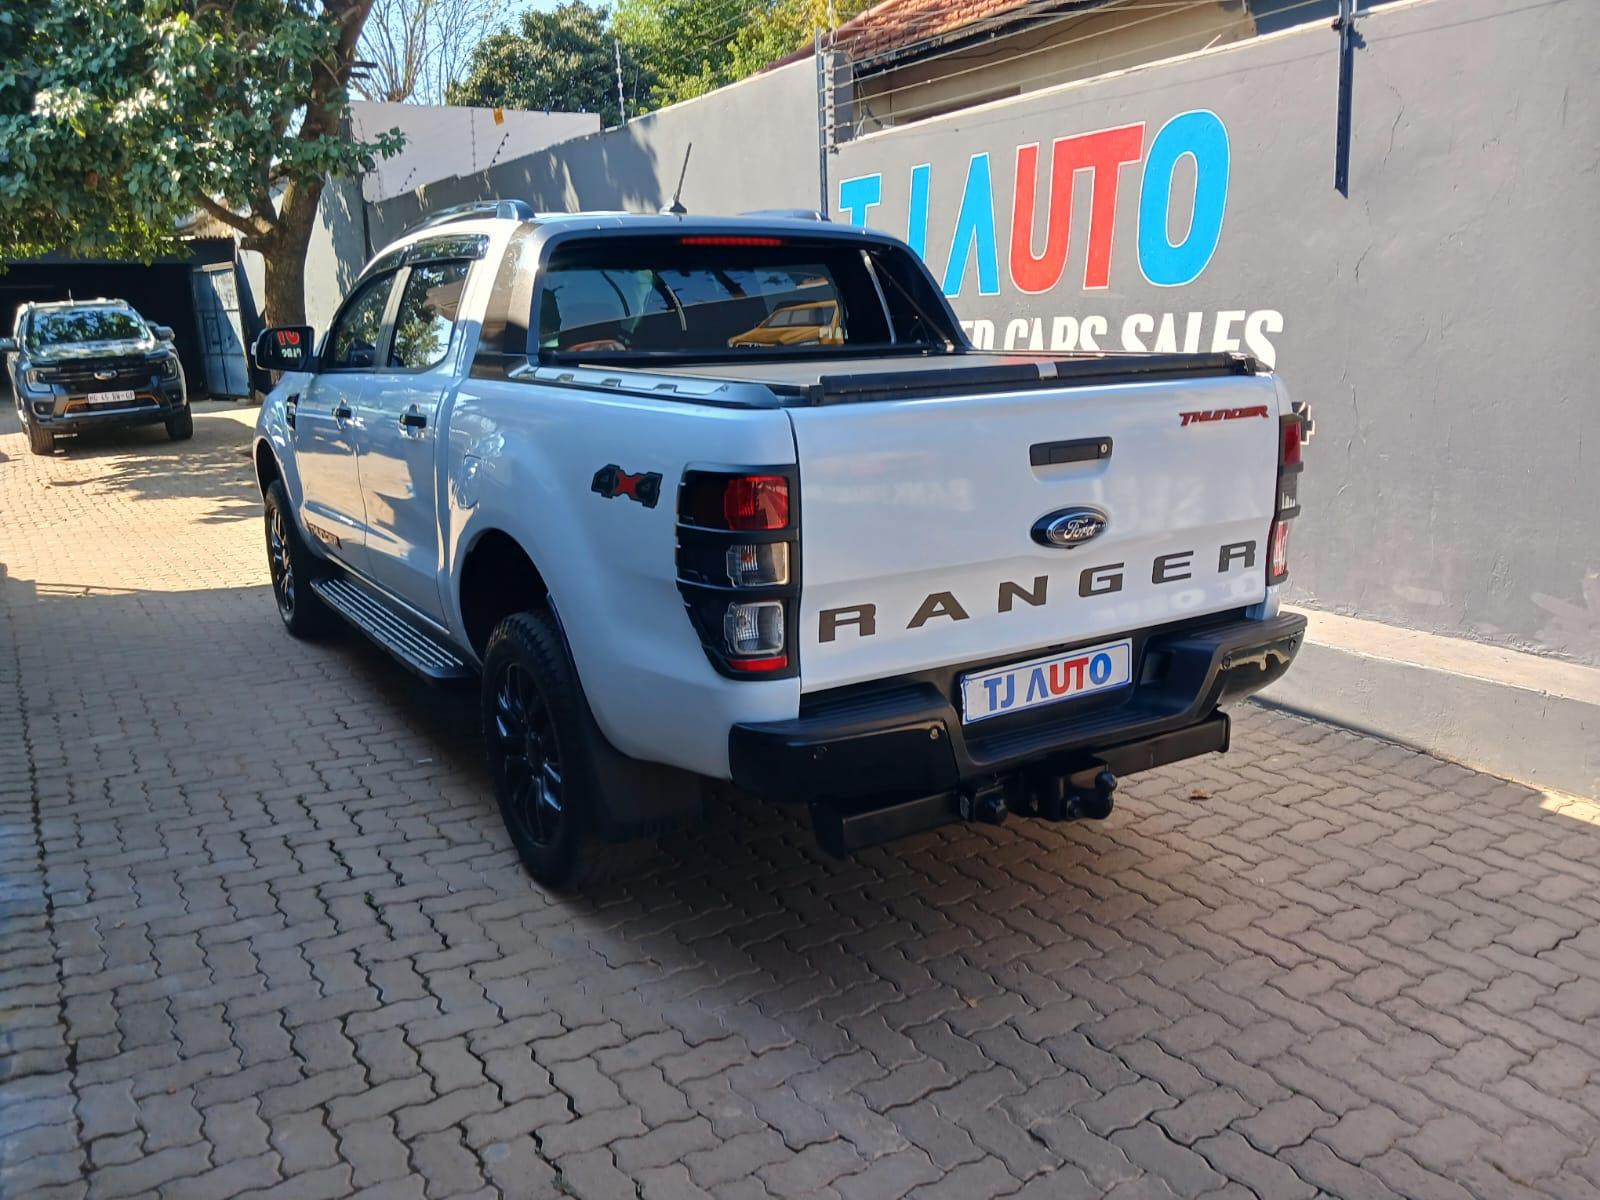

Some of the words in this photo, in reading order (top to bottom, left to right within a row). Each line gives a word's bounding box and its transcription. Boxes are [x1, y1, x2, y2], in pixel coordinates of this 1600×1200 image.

[940, 108, 1231, 297] AUTO
[1179, 405, 1269, 427] THUNDER
[1062, 518, 1097, 540] Ford
[818, 540, 1257, 643] RANGER
[983, 672, 1015, 712] TJ
[1026, 652, 1112, 703] AUTO
